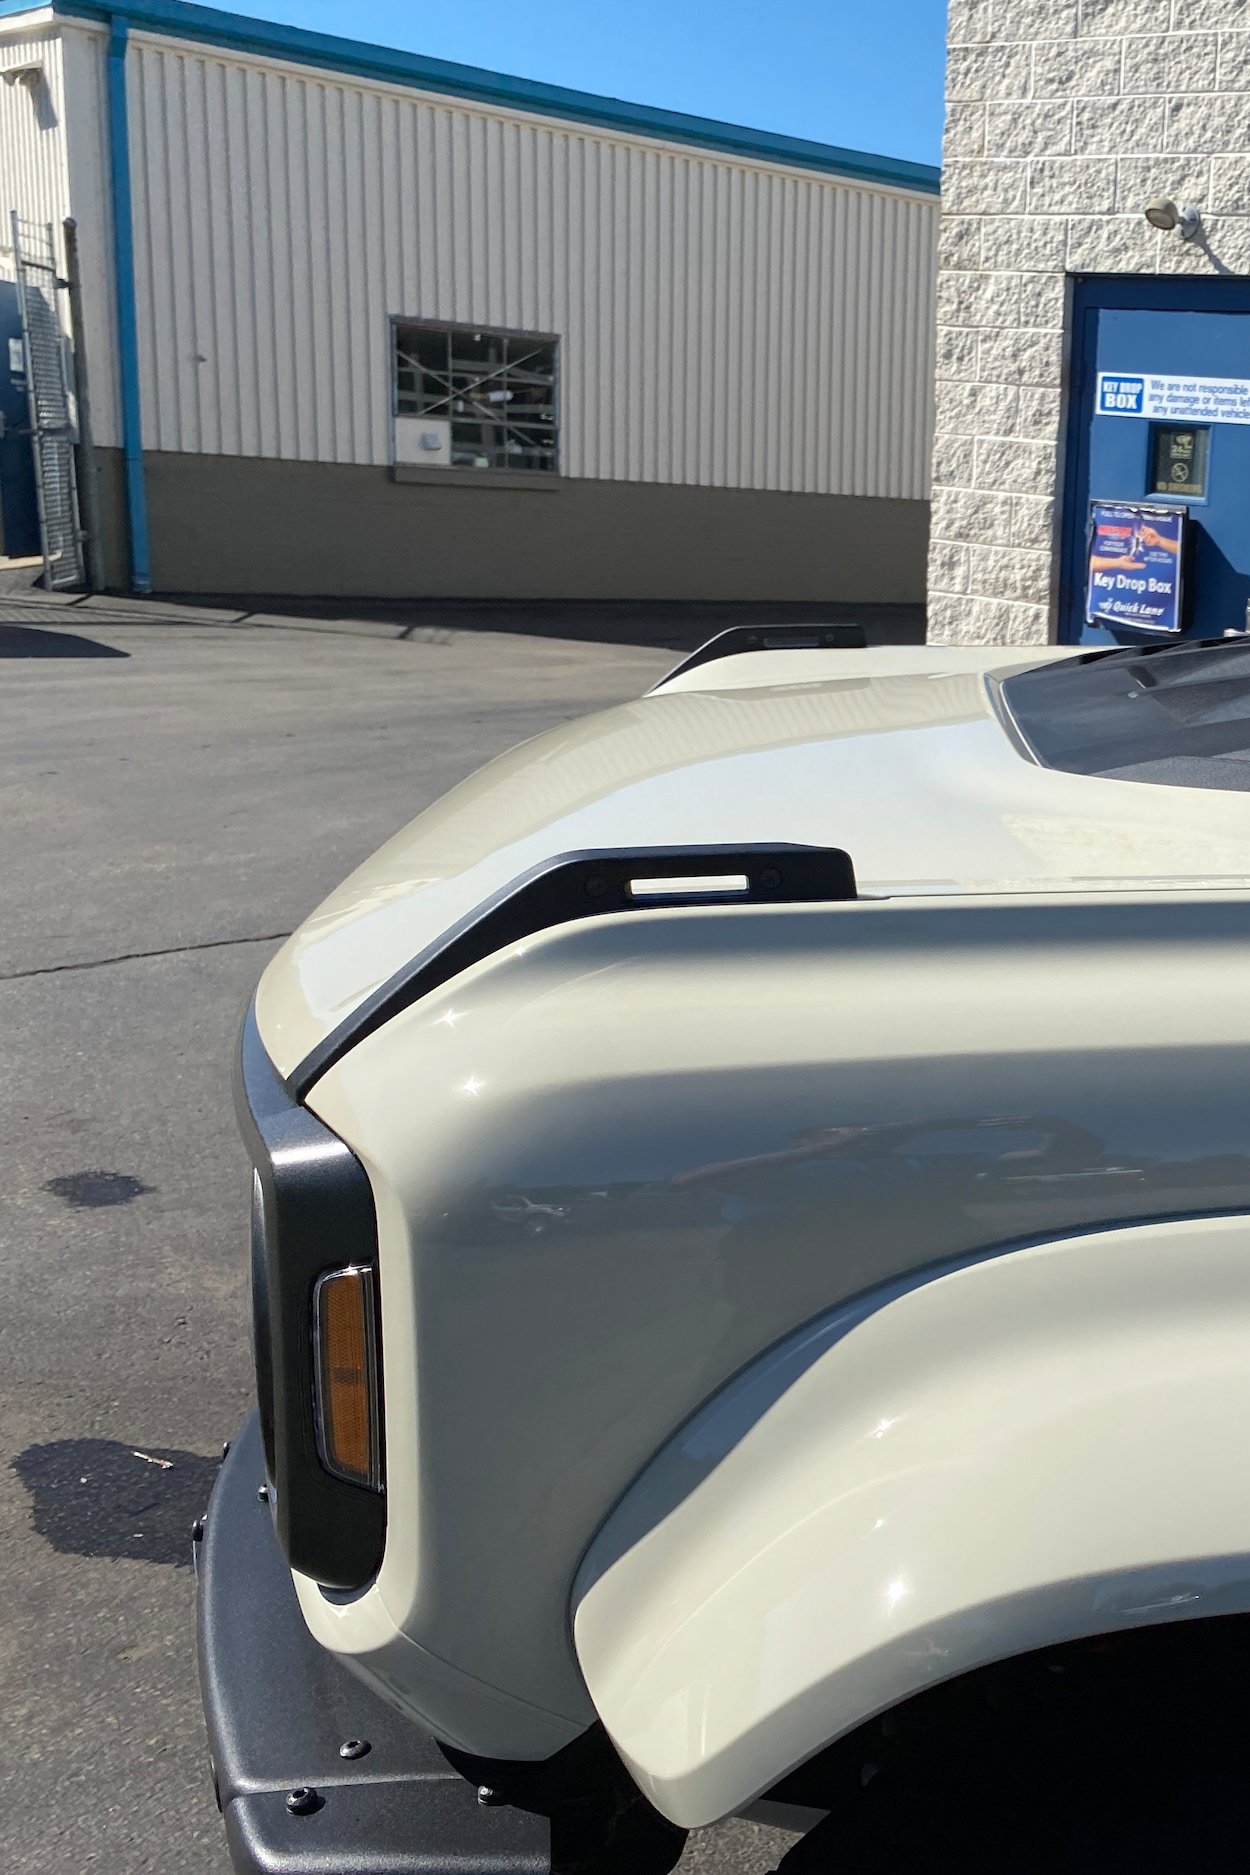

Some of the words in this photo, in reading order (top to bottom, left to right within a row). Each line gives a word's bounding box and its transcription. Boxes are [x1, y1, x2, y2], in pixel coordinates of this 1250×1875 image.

[1151, 380, 1165, 391] We
[1166, 383, 1180, 392] are
[1182, 382, 1198, 393] not
[1199, 384, 1249, 399] responsible
[1104, 393, 1137, 409] BOX
[1149, 393, 1163, 405] any
[1166, 393, 1200, 407] damage
[1202, 396, 1212, 405] or
[1213, 395, 1237, 407] items
[1152, 405, 1168, 416] any
[1170, 405, 1218, 418] unattended
[1094, 572, 1115, 591] Key
[1116, 573, 1145, 594] Drop
[1147, 578, 1172, 594] Box
[1113, 599, 1139, 614] Quick
[1139, 603, 1165, 617] Lane
